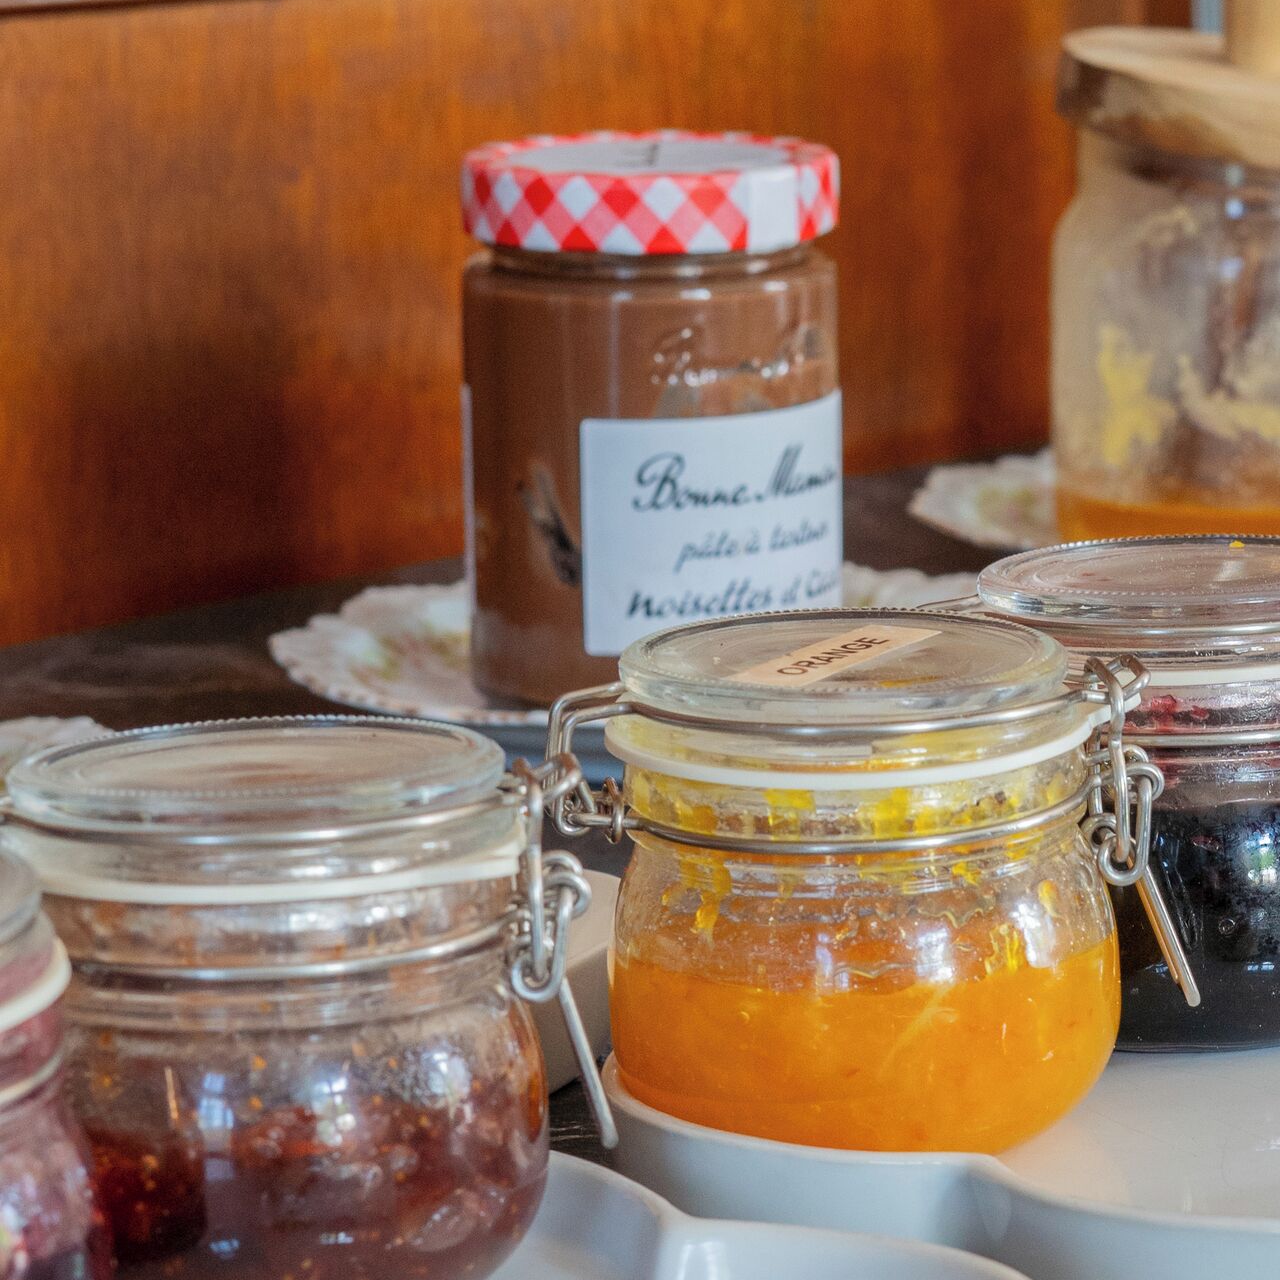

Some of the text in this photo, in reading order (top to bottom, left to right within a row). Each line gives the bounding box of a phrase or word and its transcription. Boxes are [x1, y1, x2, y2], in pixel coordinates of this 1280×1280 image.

[631, 451, 749, 512] Bonne
[627, 577, 773, 618] noisettes
[777, 637, 890, 675] ORANGE
